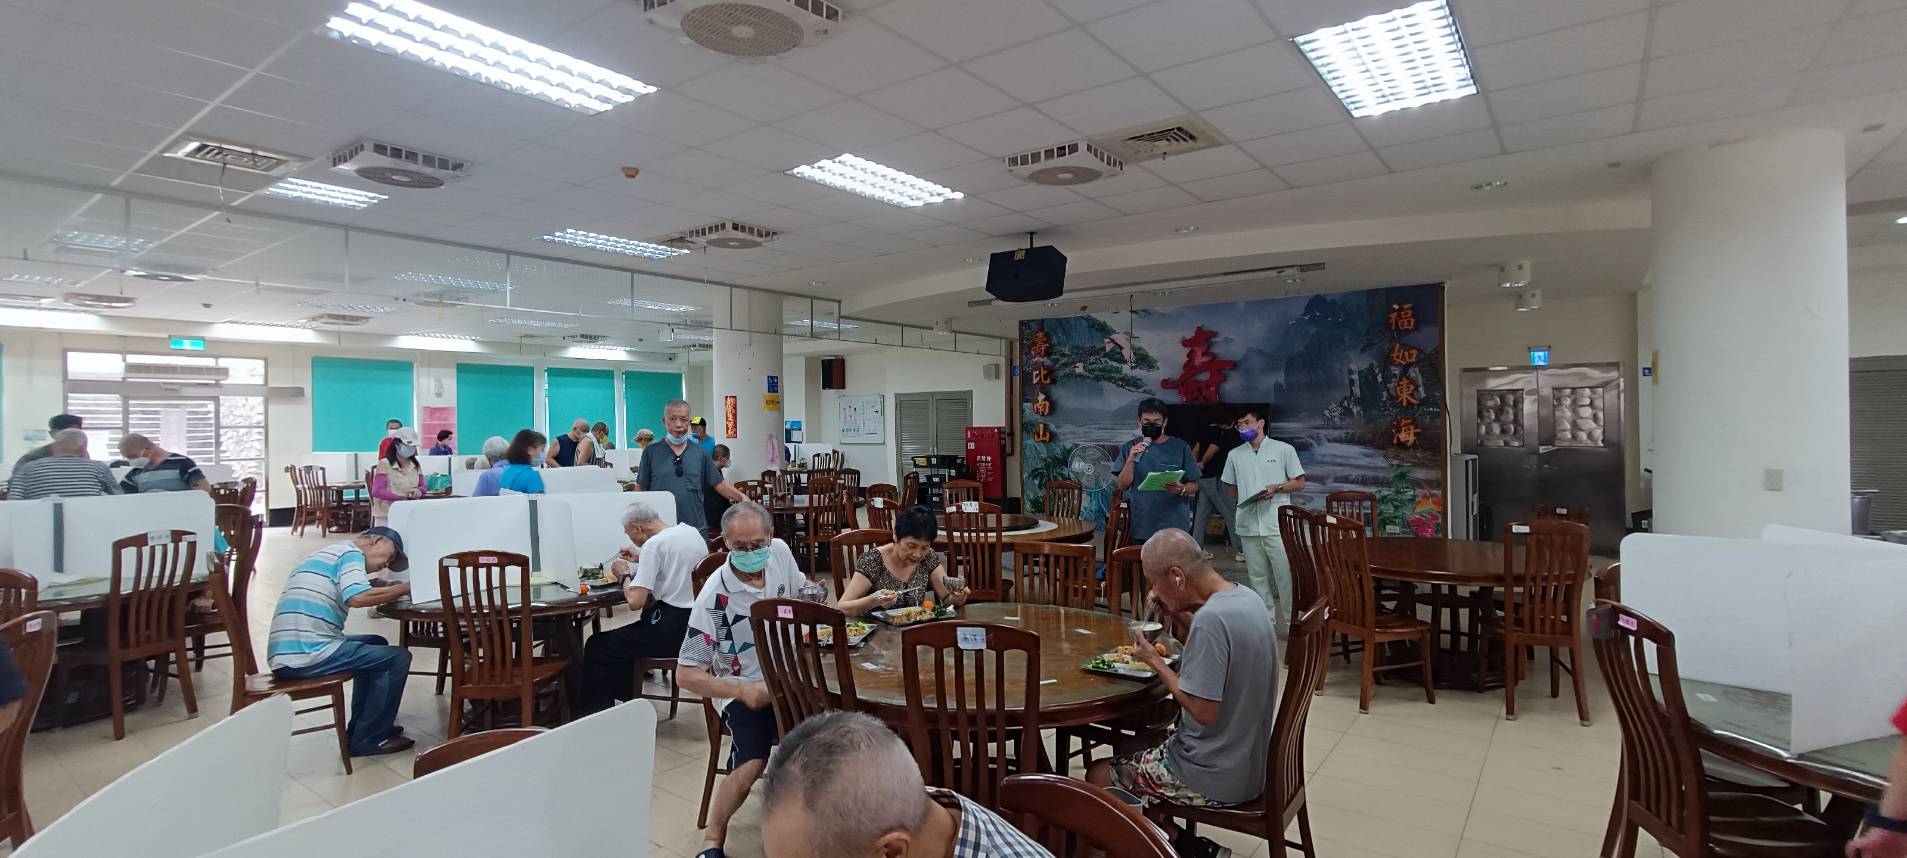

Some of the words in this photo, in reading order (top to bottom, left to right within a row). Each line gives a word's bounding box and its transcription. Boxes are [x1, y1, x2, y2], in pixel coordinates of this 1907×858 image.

[1031, 331, 1051, 442] 壽比南山
[1389, 304, 1420, 446] 福如東海
